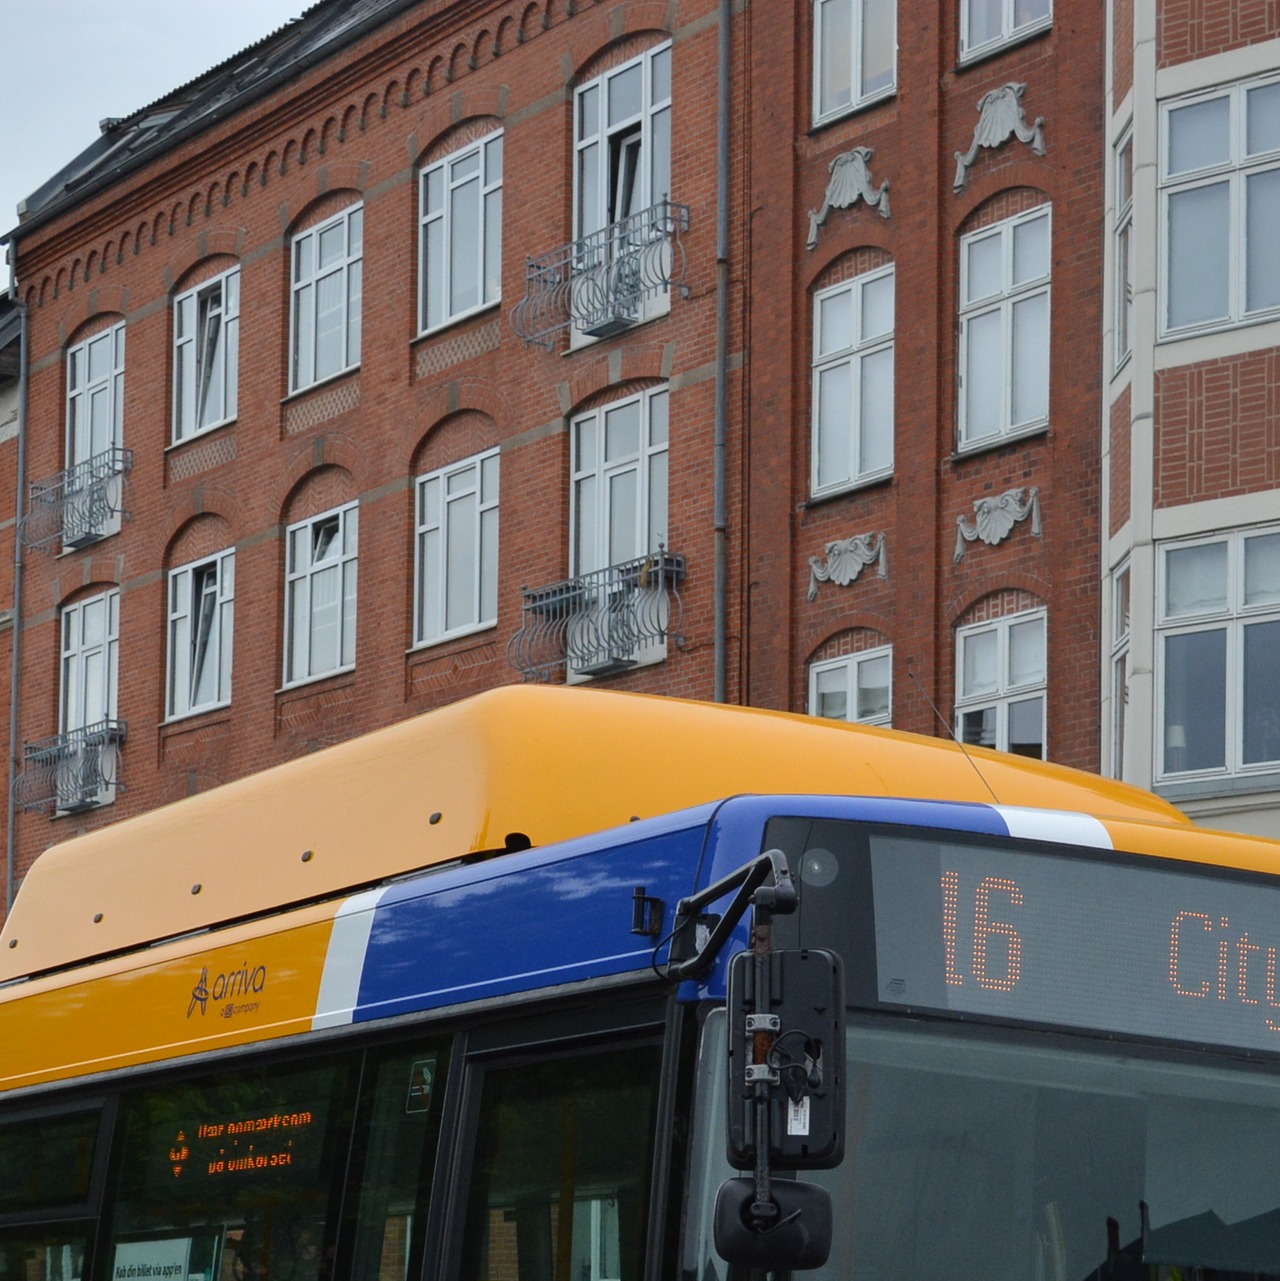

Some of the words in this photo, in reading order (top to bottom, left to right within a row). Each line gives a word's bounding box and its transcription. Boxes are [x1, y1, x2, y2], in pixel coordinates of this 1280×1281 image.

[940, 870, 1024, 992] 16
[212, 961, 266, 1001] arriva
[127, 1264, 136, 1278] din
[137, 1263, 152, 1277] billet
[153, 1262, 162, 1276] via
